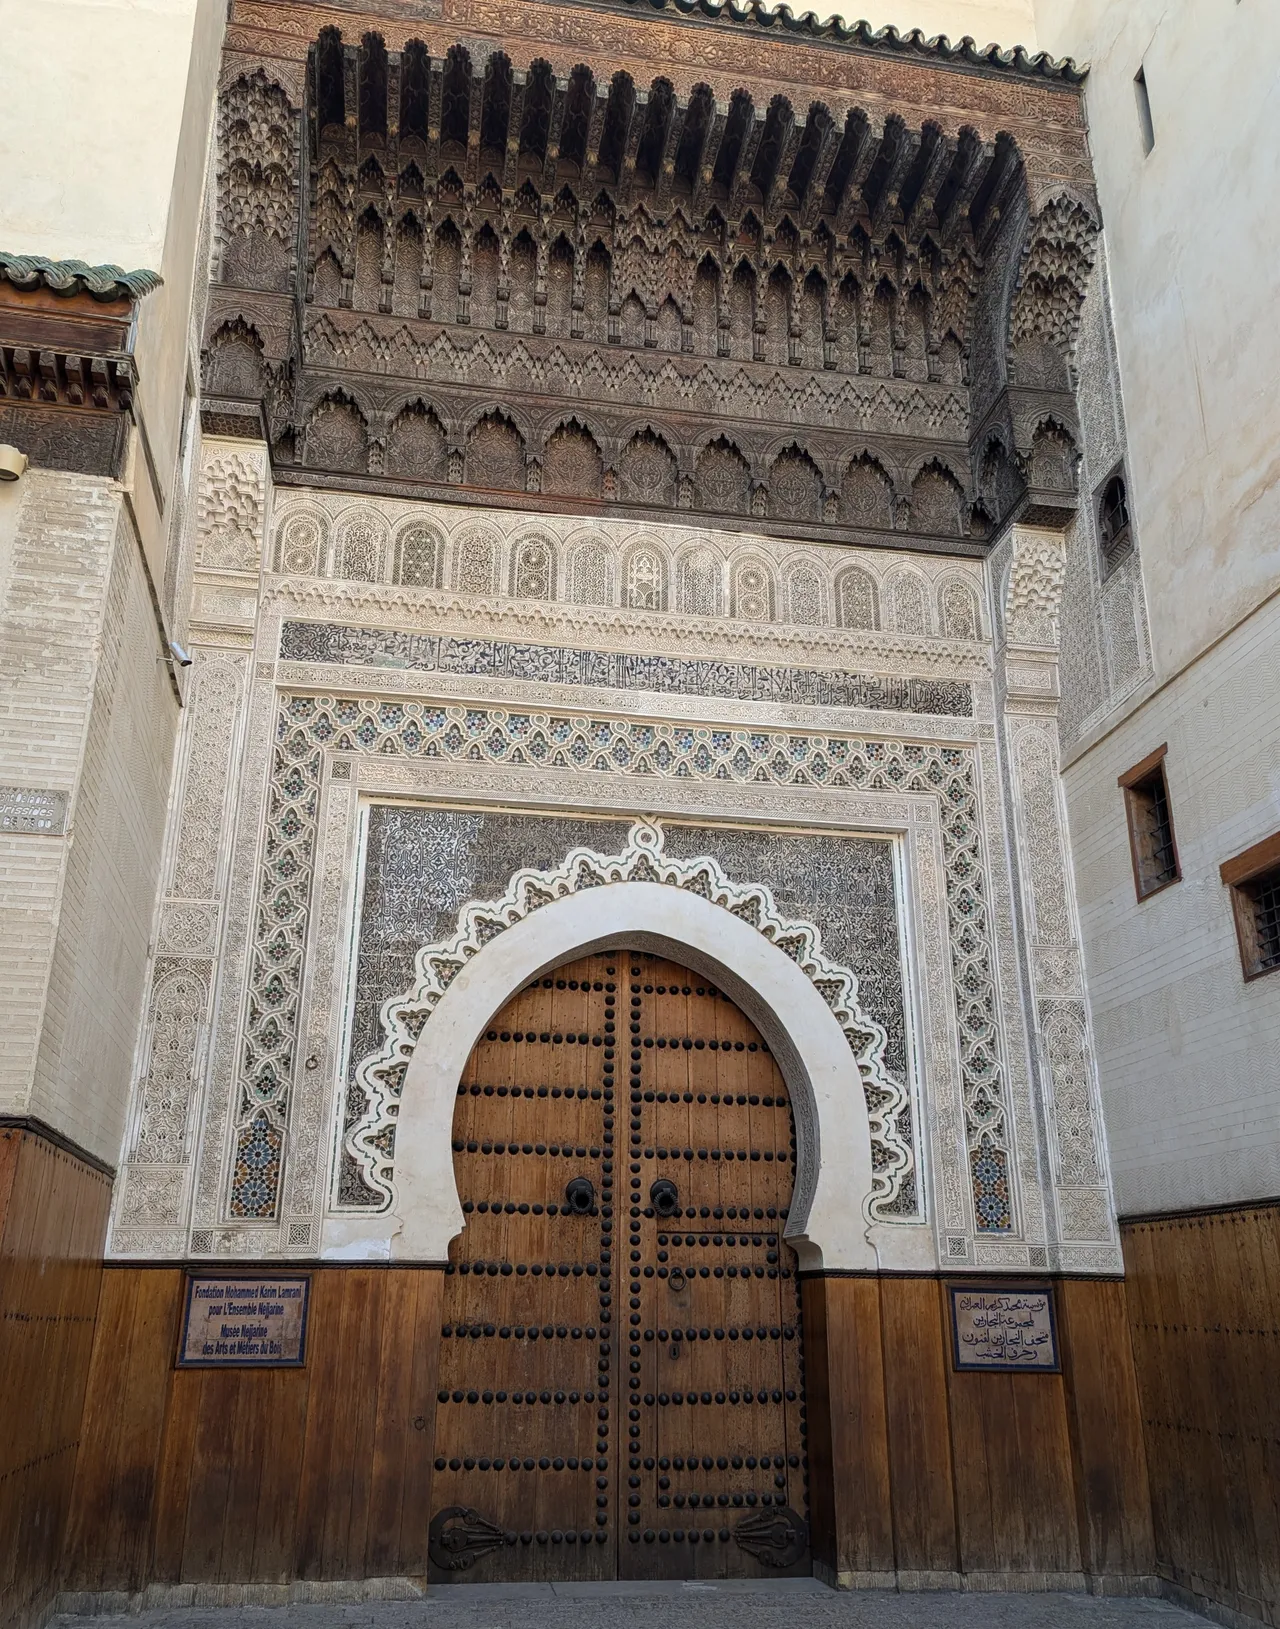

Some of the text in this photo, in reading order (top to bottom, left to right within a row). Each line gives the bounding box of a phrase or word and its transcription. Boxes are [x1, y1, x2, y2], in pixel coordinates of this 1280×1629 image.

[195, 1285, 302, 1299] Fondation Mohammed Karim Lamrani
[208, 1304, 223, 1319] pour
[257, 1302, 284, 1319] Nejjarine
[985, 1297, 1011, 1311] كريم
[1021, 1298, 1047, 1312] مؤسسة
[220, 1324, 268, 1341] Musée Nejjarine
[991, 1330, 1023, 1347] النجارين
[1024, 1331, 1049, 1346] متحف
[202, 1341, 283, 1355] des Arts et Métiers du Bois
